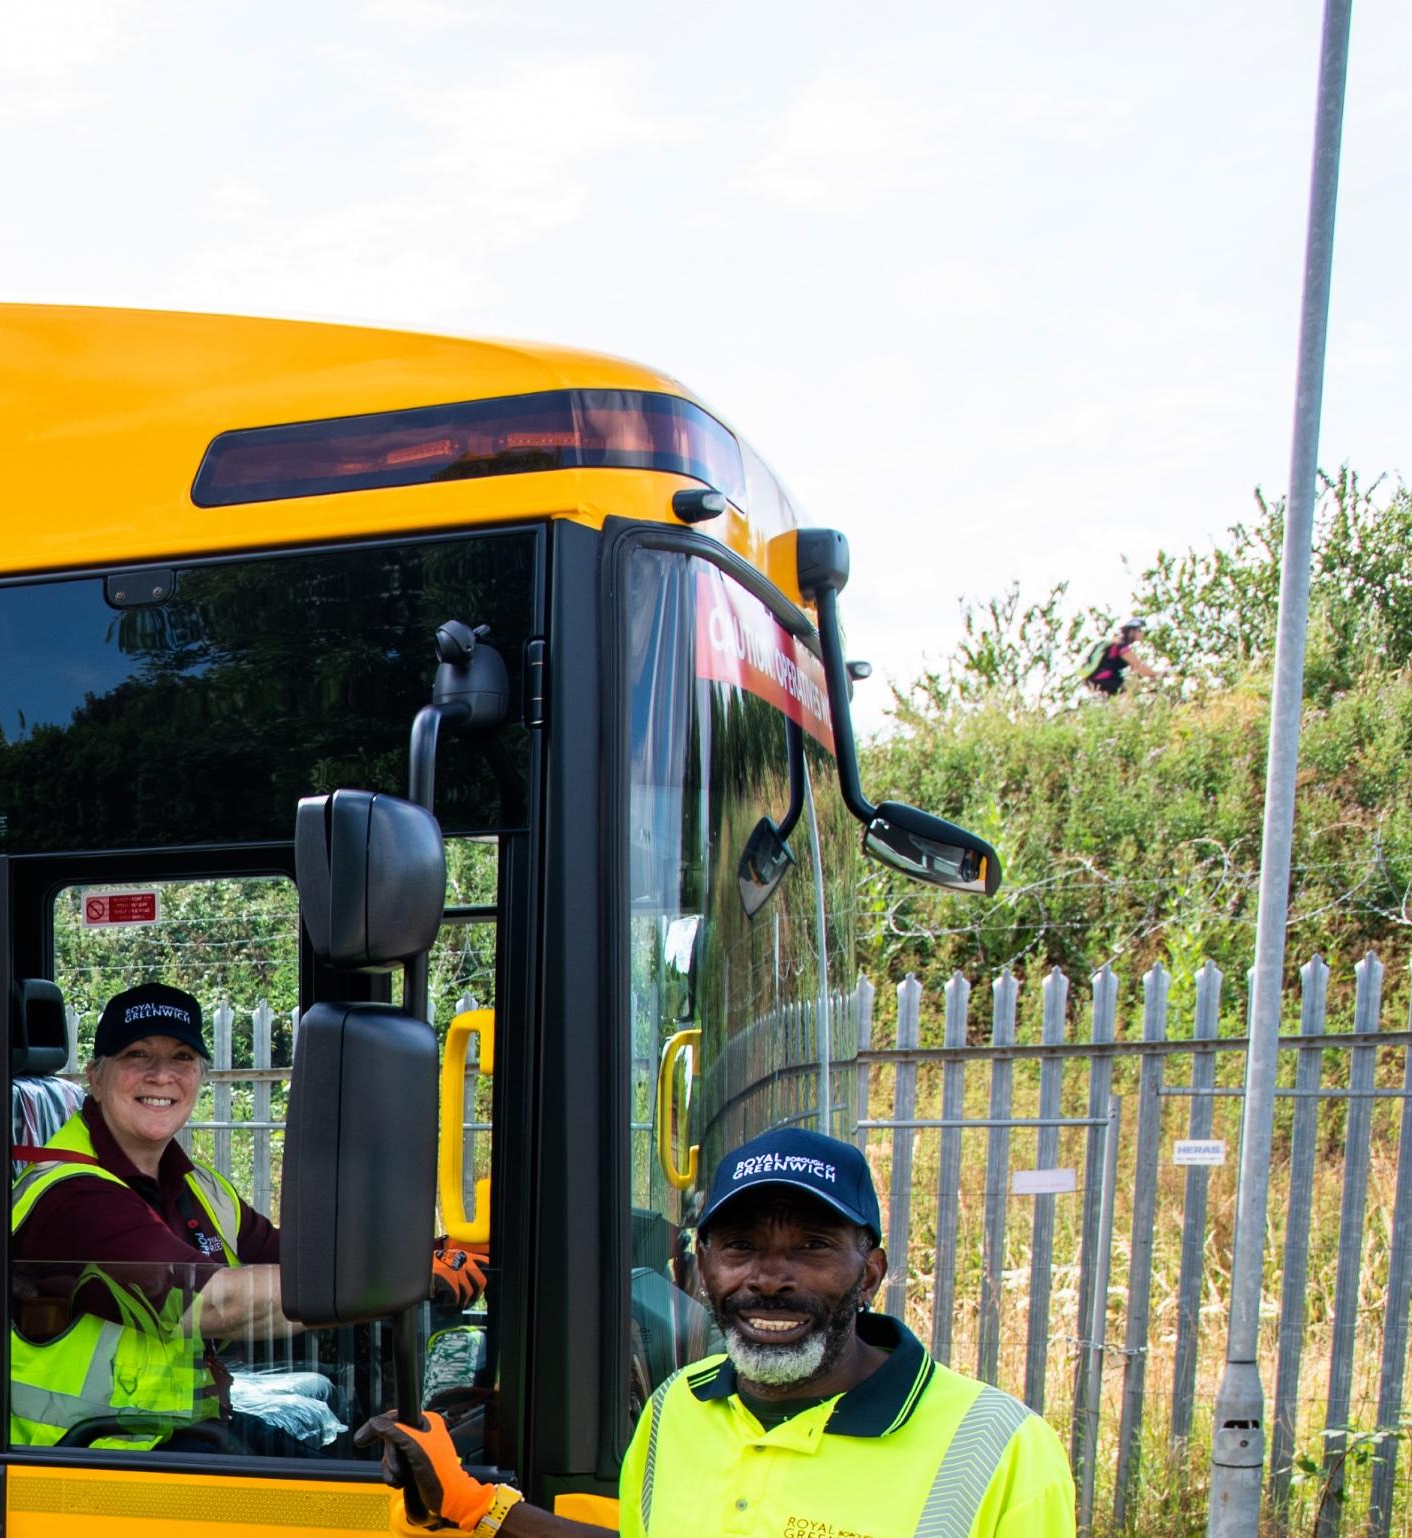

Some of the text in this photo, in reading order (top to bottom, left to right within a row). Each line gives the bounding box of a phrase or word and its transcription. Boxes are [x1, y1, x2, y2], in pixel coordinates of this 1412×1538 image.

[125, 1002, 156, 1015] ROYAL
[125, 1009, 191, 1024] GREENWICH
[1177, 1146, 1221, 1154] HERAS
[736, 1153, 783, 1171] ROYAL
[785, 1156, 824, 1168] BOROUGH
[733, 1161, 836, 1183] GREENWICH
[787, 1516, 834, 1535] ROYAL
